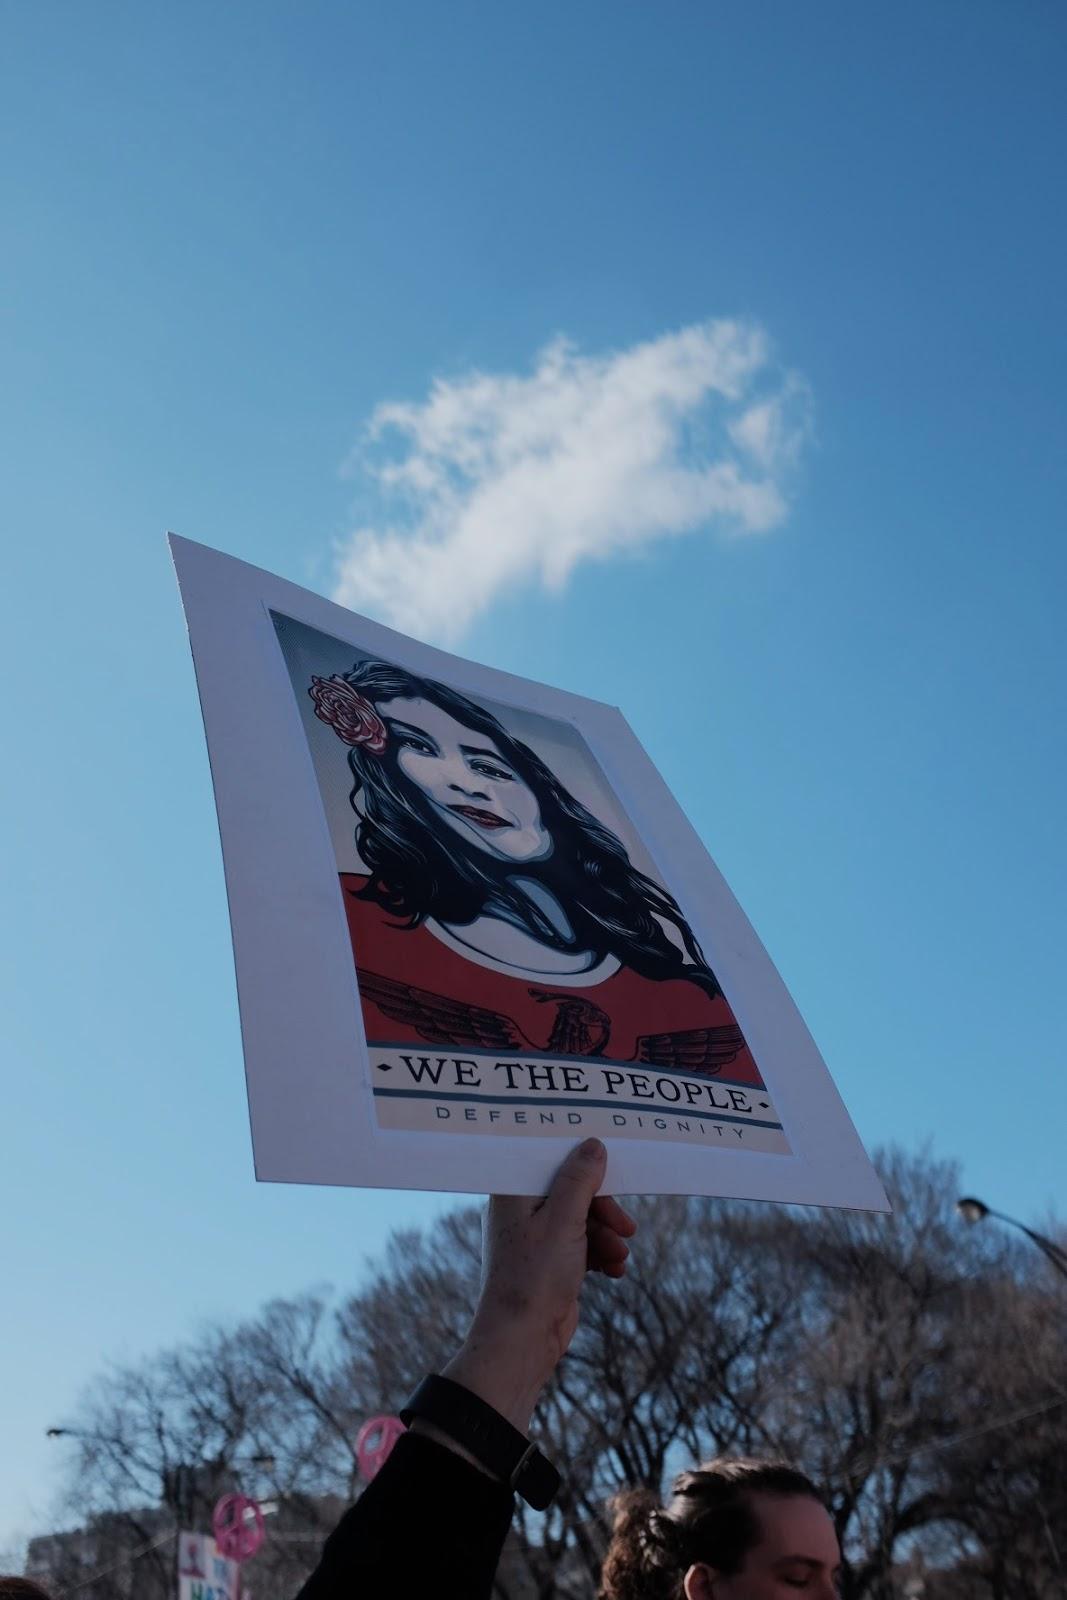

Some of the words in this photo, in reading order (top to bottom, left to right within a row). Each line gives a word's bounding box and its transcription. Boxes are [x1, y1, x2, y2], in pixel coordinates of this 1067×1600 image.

[399, 1055, 482, 1087] WE
[494, 1062, 589, 1093] THE
[601, 1069, 753, 1113] PEOPLE
[436, 1106, 582, 1125] DEFEND
[613, 1114, 744, 1139] DIGNITY
